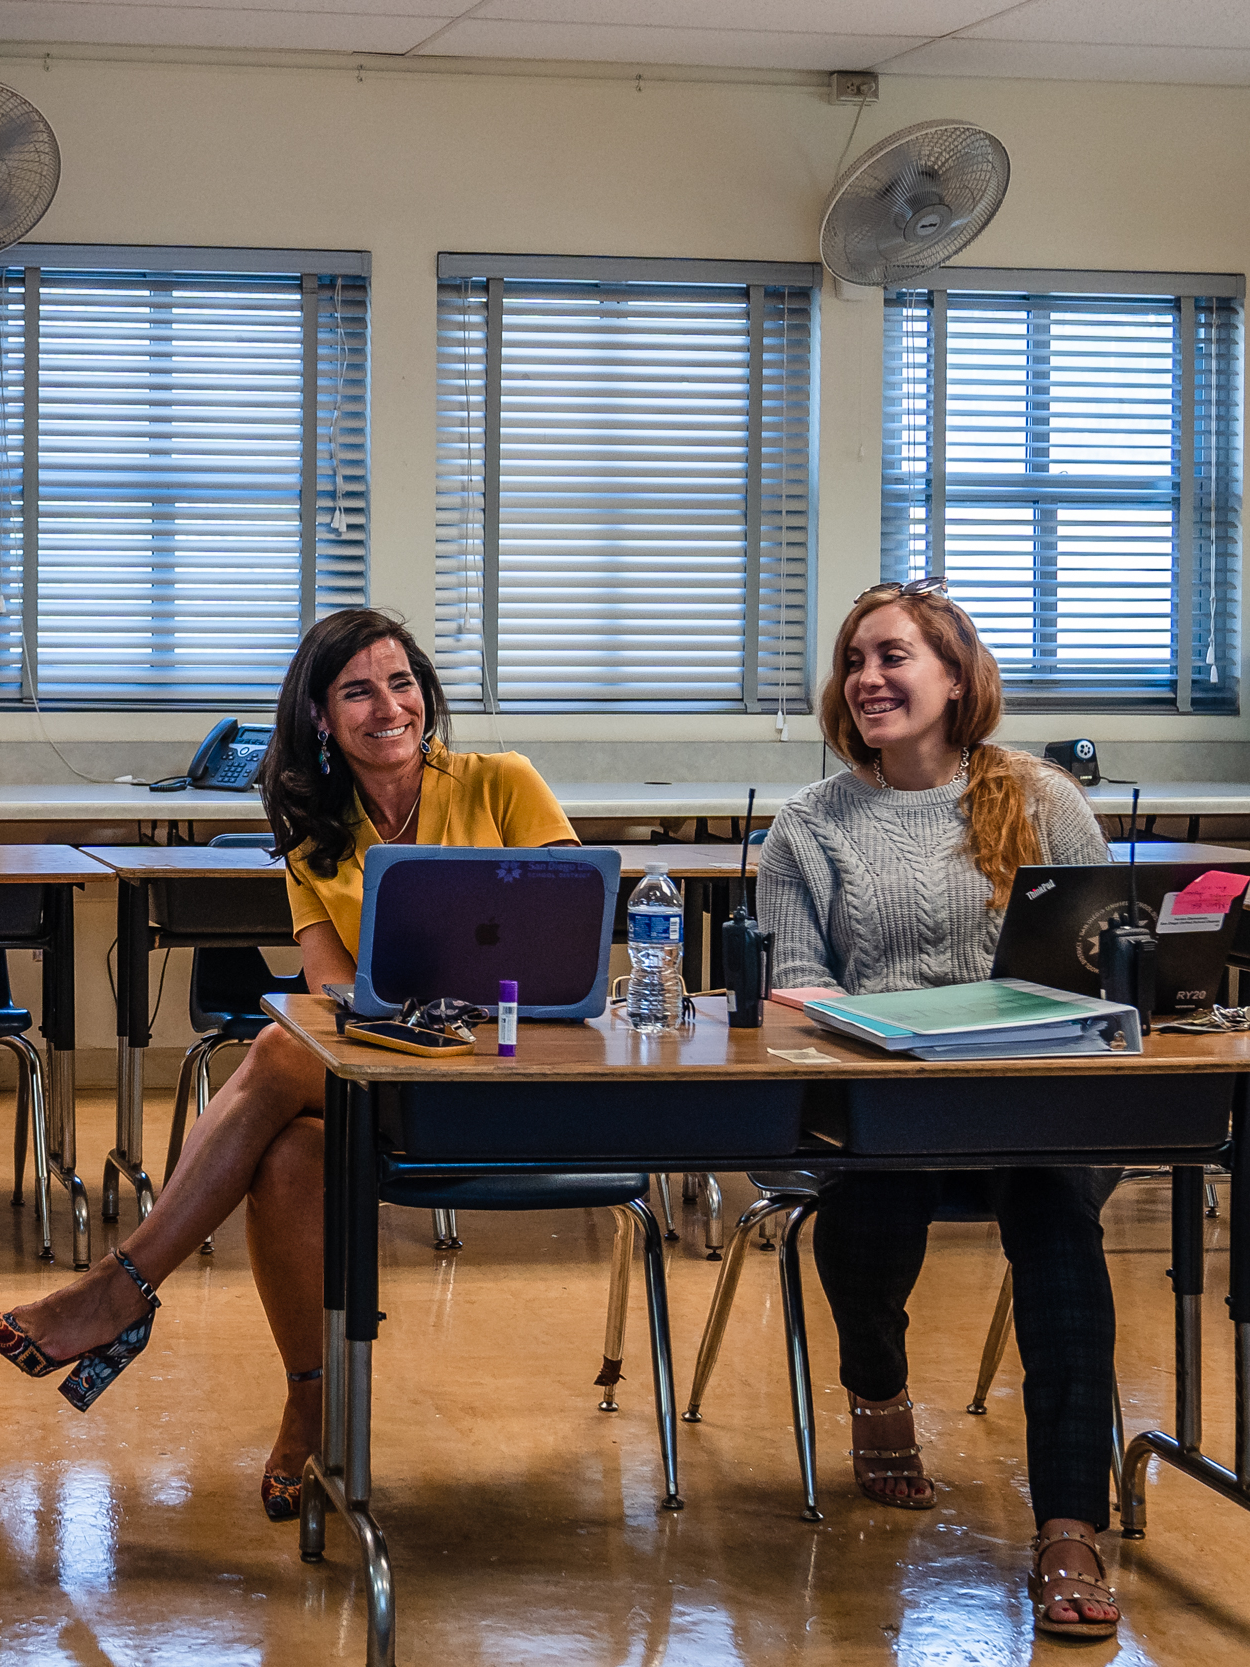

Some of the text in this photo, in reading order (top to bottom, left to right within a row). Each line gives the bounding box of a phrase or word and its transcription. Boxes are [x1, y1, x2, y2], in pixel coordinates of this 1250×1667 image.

[528, 861, 547, 871] San
[548, 861, 576, 873] Diego
[1025, 878, 1056, 900] ThinkPad
[1176, 990, 1206, 1000] RY20
